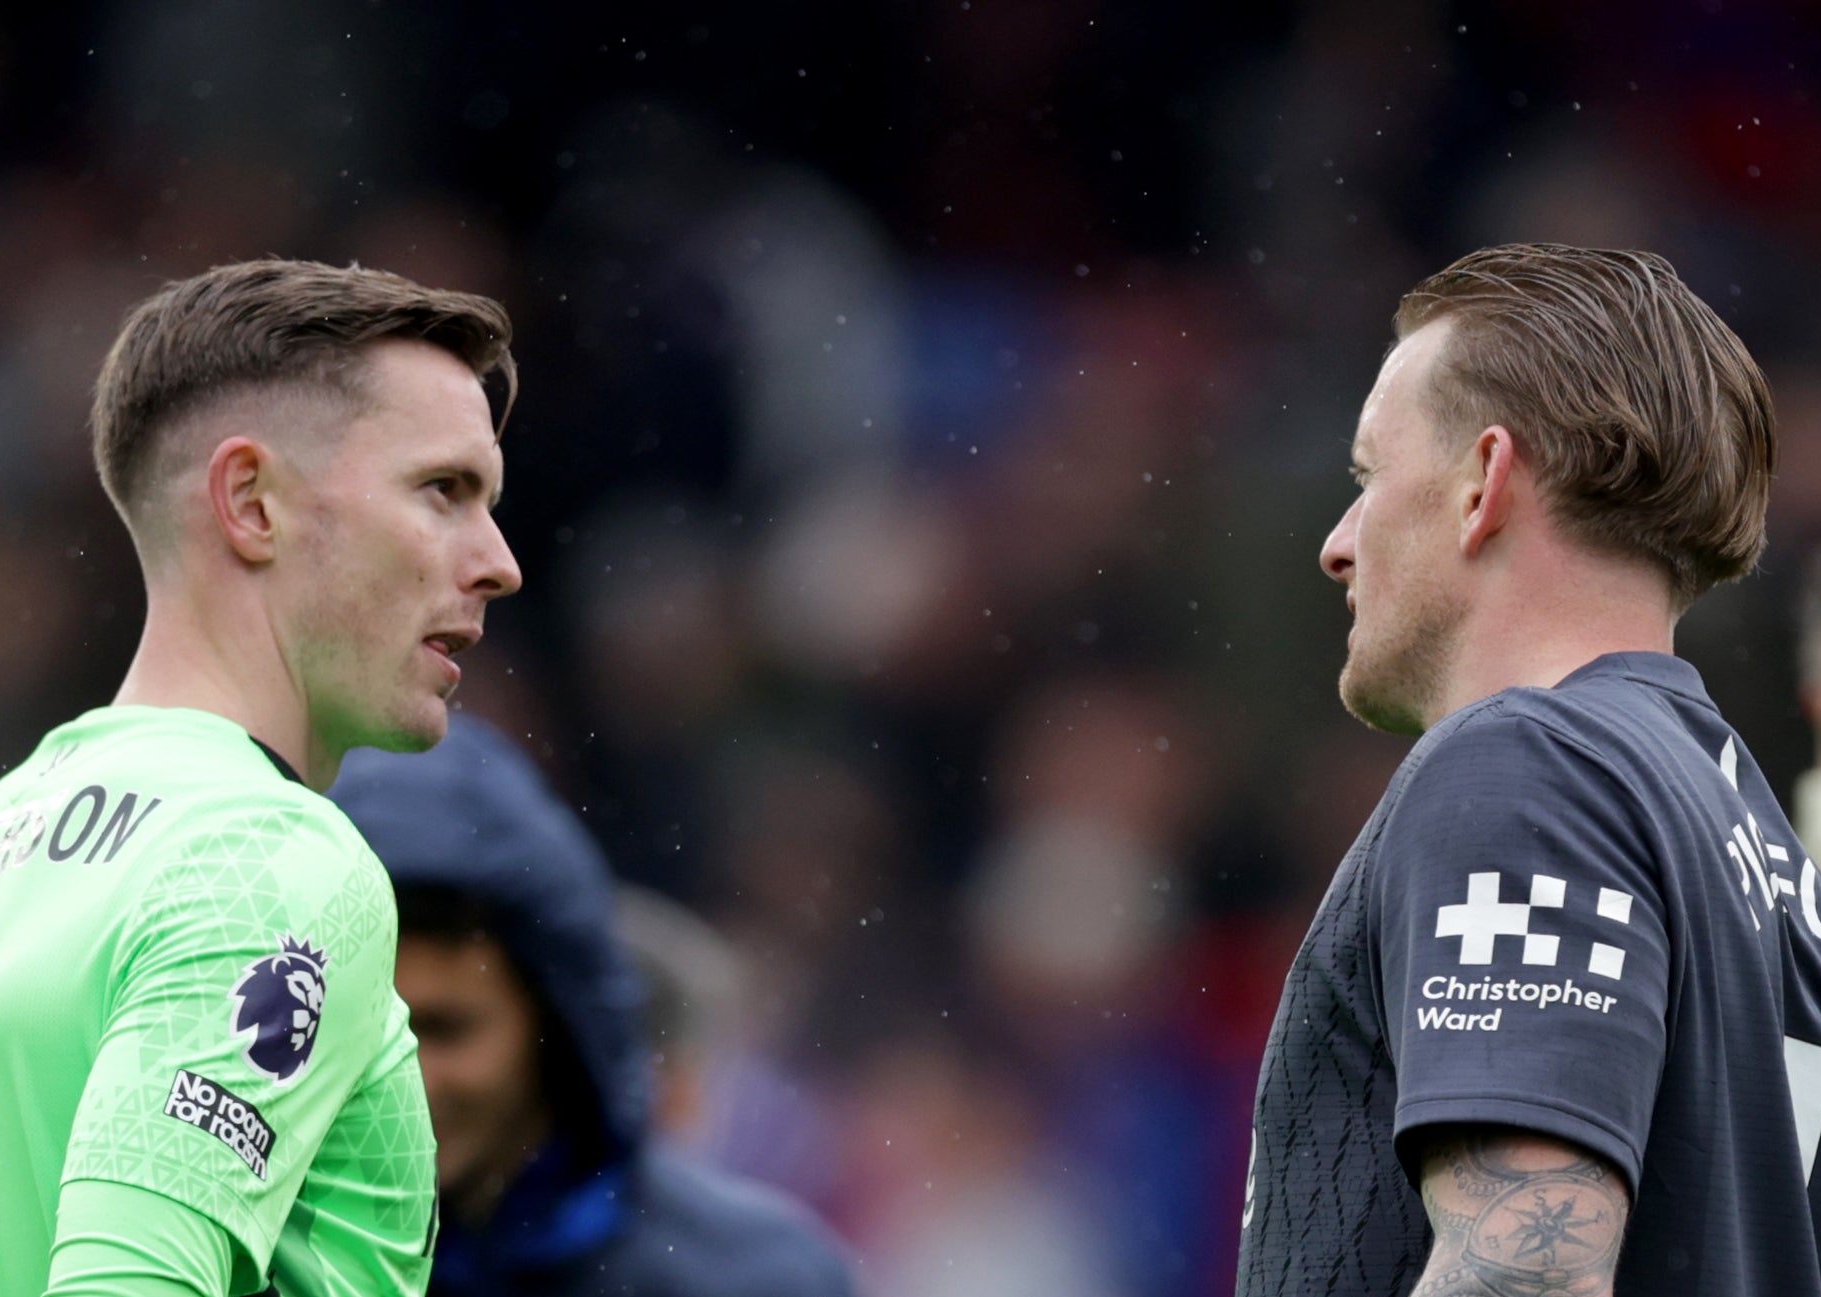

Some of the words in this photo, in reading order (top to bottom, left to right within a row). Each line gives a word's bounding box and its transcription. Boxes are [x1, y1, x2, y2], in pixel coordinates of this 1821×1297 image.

[1417, 1006, 1503, 1031] Ward
[1421, 975, 1618, 1014] Christopher
[164, 1092, 211, 1127] for
[209, 1114, 267, 1181] racism
[172, 1069, 217, 1106] No
[217, 1094, 270, 1153] room
